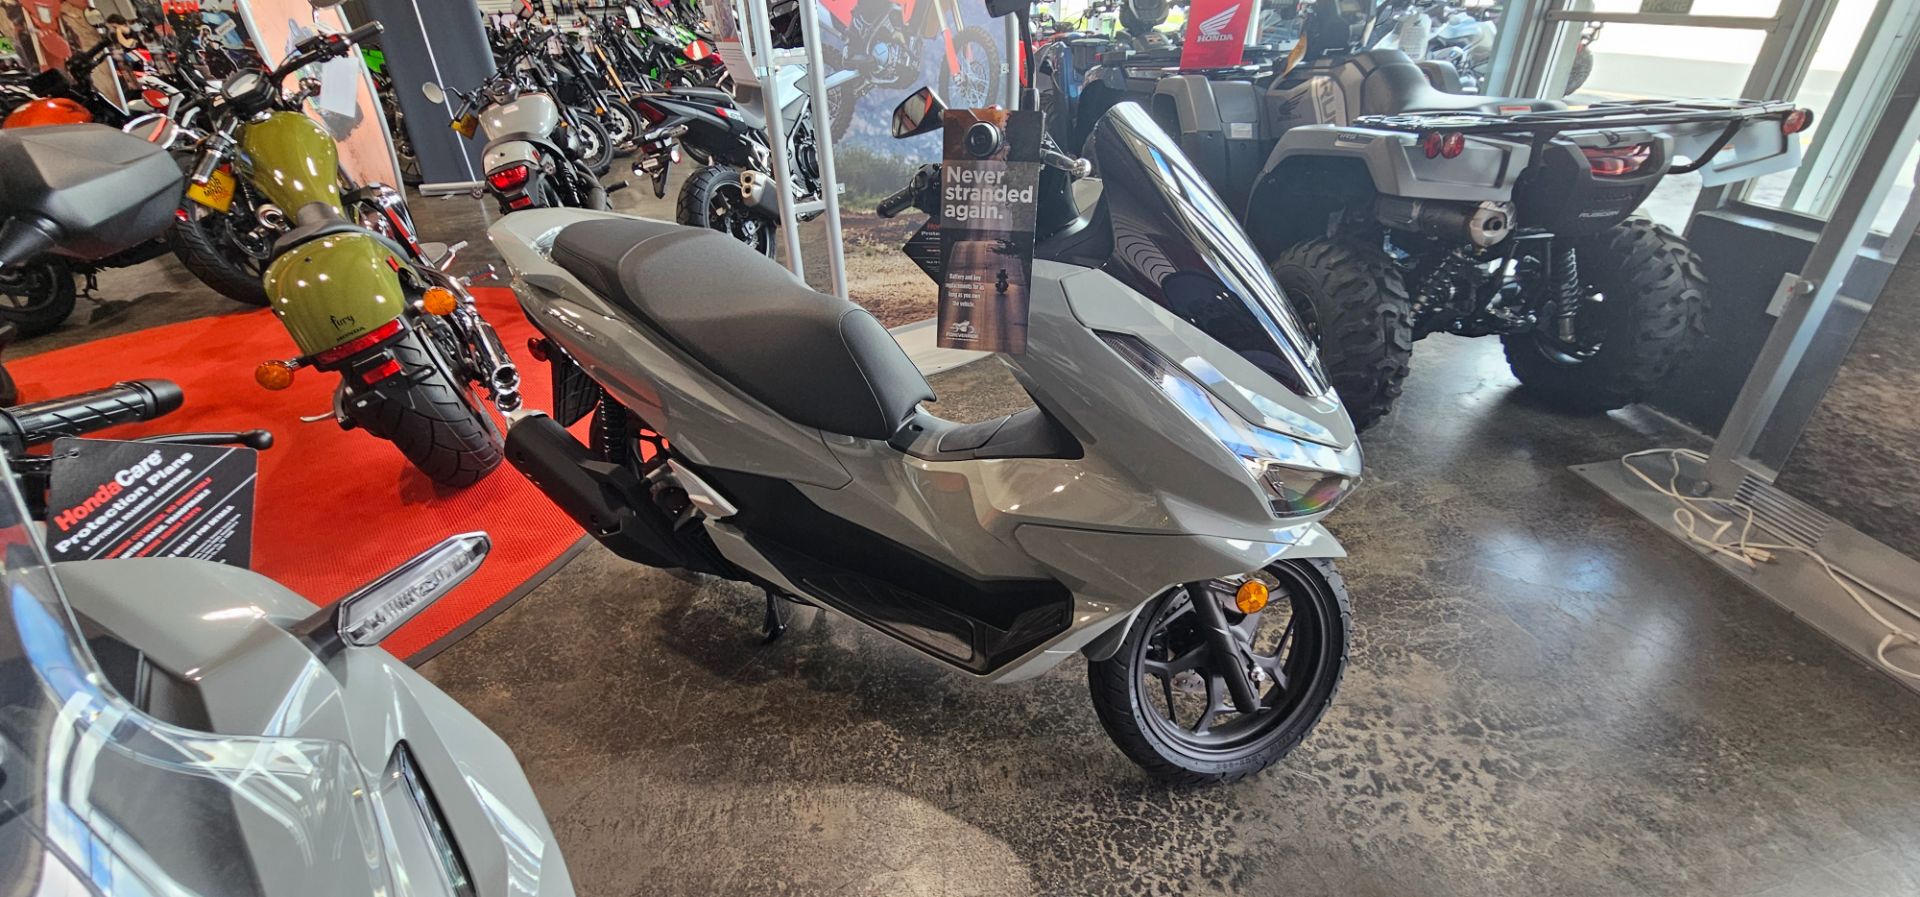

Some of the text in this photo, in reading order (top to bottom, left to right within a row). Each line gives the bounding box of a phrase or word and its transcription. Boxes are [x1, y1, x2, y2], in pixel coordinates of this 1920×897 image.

[1197, 34, 1233, 42] HONDA
[946, 166, 1005, 184] Never
[945, 184, 1033, 203] stranded
[944, 202, 1003, 221] again.
[949, 273, 965, 281] Battery
[336, 326, 365, 341] HONDA
[54, 485, 149, 553] Protection
[146, 452, 194, 486] Plans
[88, 520, 126, 547] OPTIONAL
[196, 524, 211, 536] FOR
